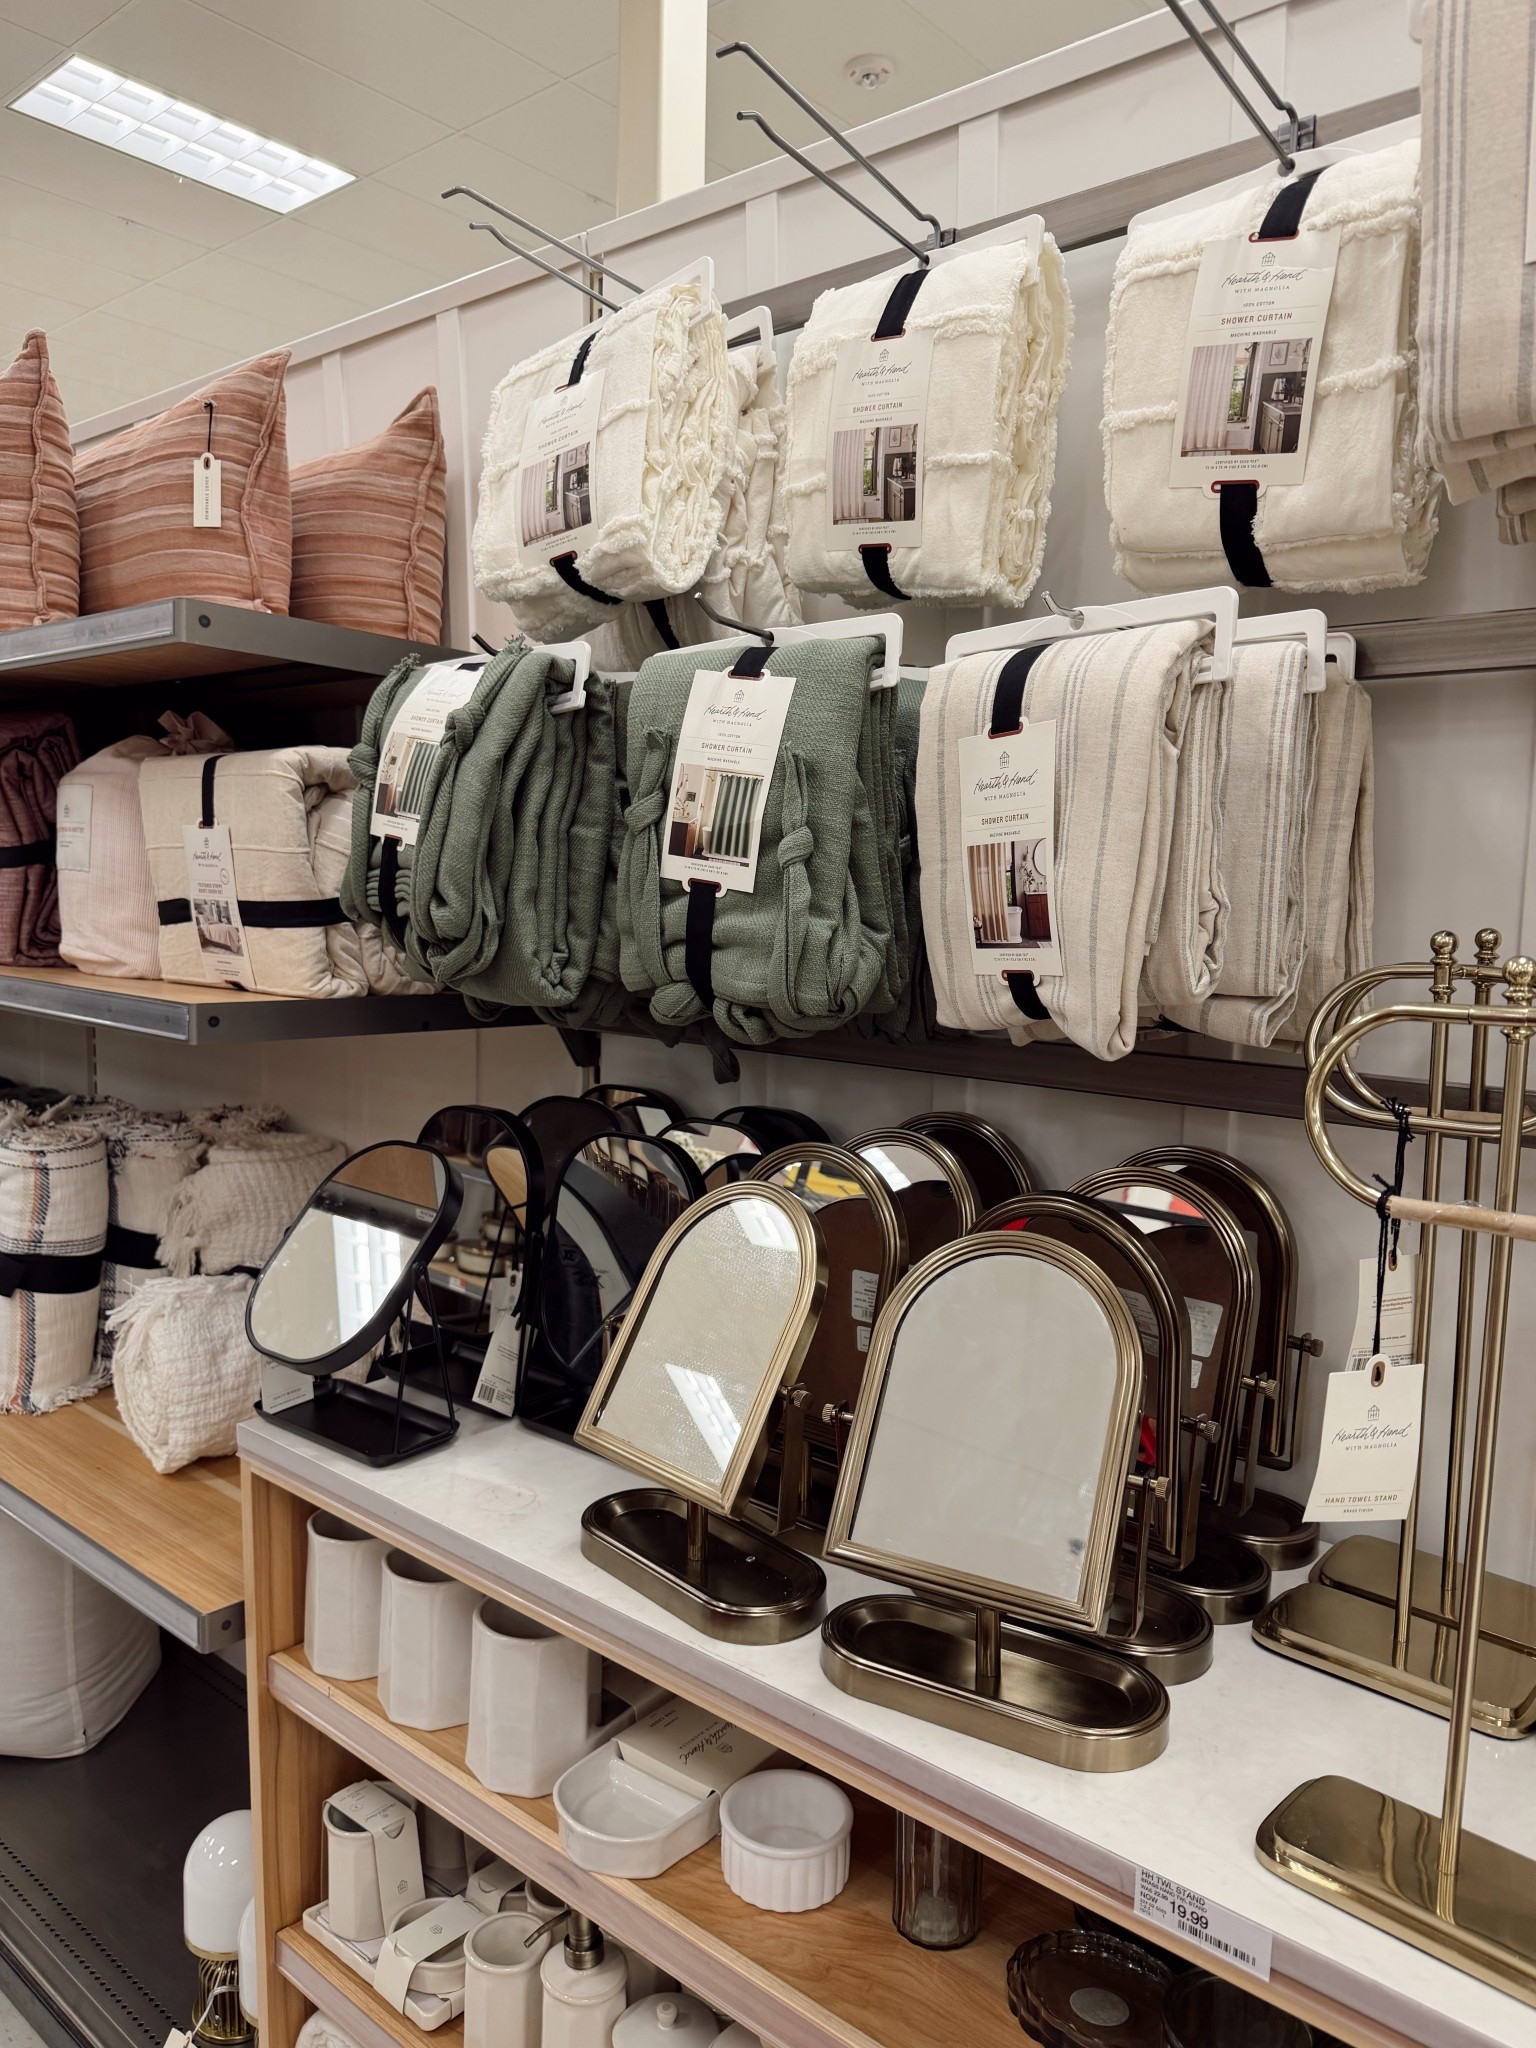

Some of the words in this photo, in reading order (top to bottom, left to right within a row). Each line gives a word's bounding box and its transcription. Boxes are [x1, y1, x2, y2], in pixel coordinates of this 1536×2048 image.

[1221, 269, 1267, 288] Hearth
[1268, 268, 1308, 284] Hand
[1220, 314, 1255, 326] SHOWER
[1256, 312, 1293, 322] CURTAIN
[852, 404, 877, 414] SHOWER
[878, 402, 903, 410] CURTAIN
[538, 438, 558, 450] SHOWER
[558, 430, 578, 442] CURTAIN
[701, 742, 726, 751] SHOWER
[726, 745, 752, 754] CURTAIN
[974, 772, 1005, 794] Hearth
[1008, 768, 1038, 788] Hand
[982, 816, 1004, 826] SHOWER
[1004, 813, 1030, 823] CURTAIN
[1331, 1424, 1374, 1444] Hearth
[1376, 1422, 1412, 1440] Hand
[1140, 1884, 1153, 1894] WAS
[1140, 1877, 1160, 1890] BRASS
[1160, 1886, 1176, 1898] HAND
[1176, 1894, 1188, 1904] TWL
[1188, 1900, 1208, 1914] STAND
[1141, 1869, 1154, 1881] HH
[1156, 1876, 1174, 1891] TWL
[1176, 1886, 1206, 1906] STAND
[1140, 1890, 1158, 1904] NOW
[1170, 1900, 1208, 1930] 19.99
